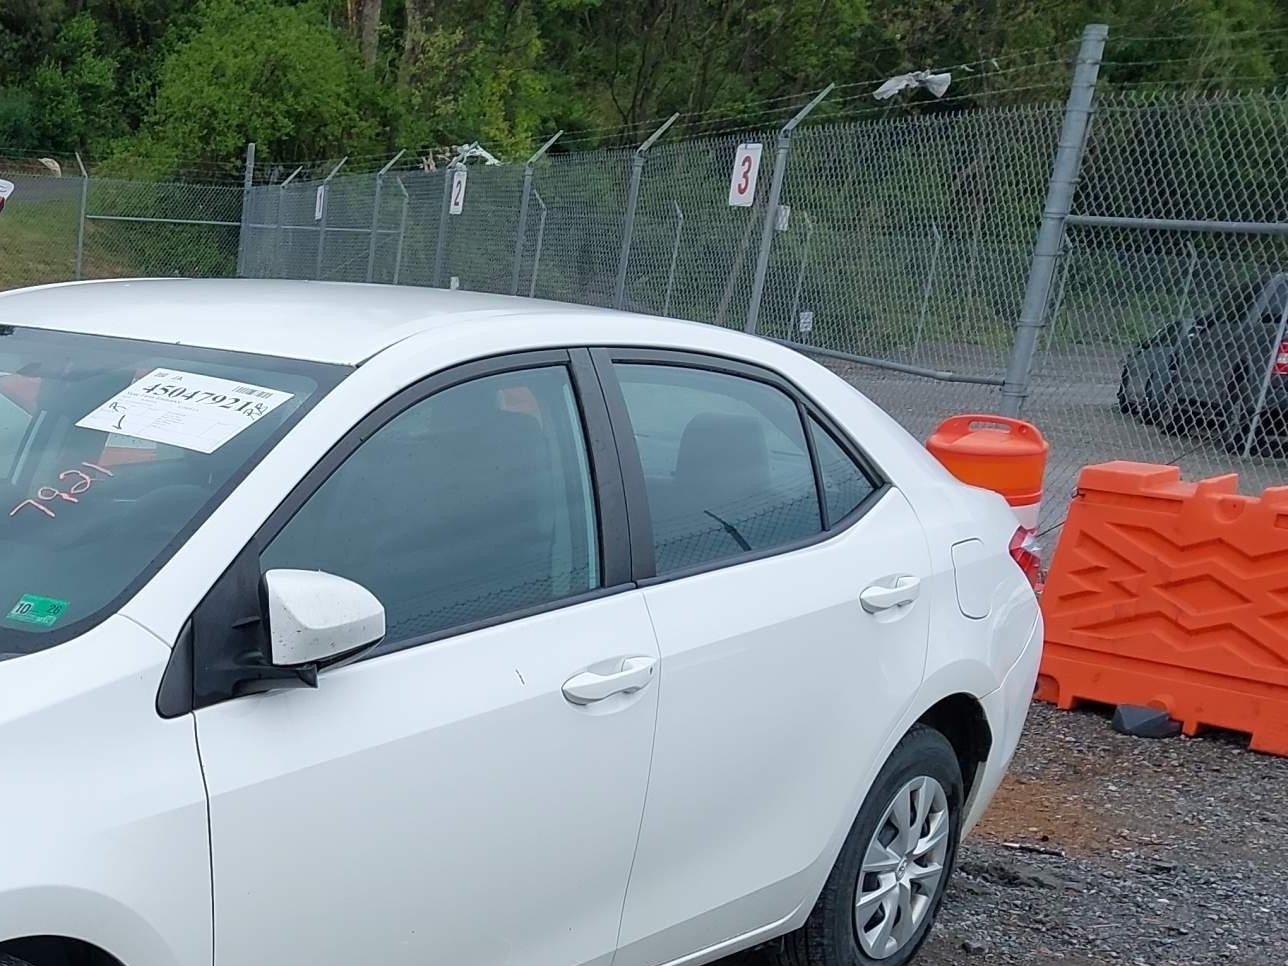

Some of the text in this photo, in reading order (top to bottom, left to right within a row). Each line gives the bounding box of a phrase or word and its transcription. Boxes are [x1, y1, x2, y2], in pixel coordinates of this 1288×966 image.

[737, 155, 752, 195] 3
[454, 180, 462, 206] 2
[143, 382, 253, 412] 45047921
[9, 462, 114, 518] 7921
[15, 602, 32, 614] 10
